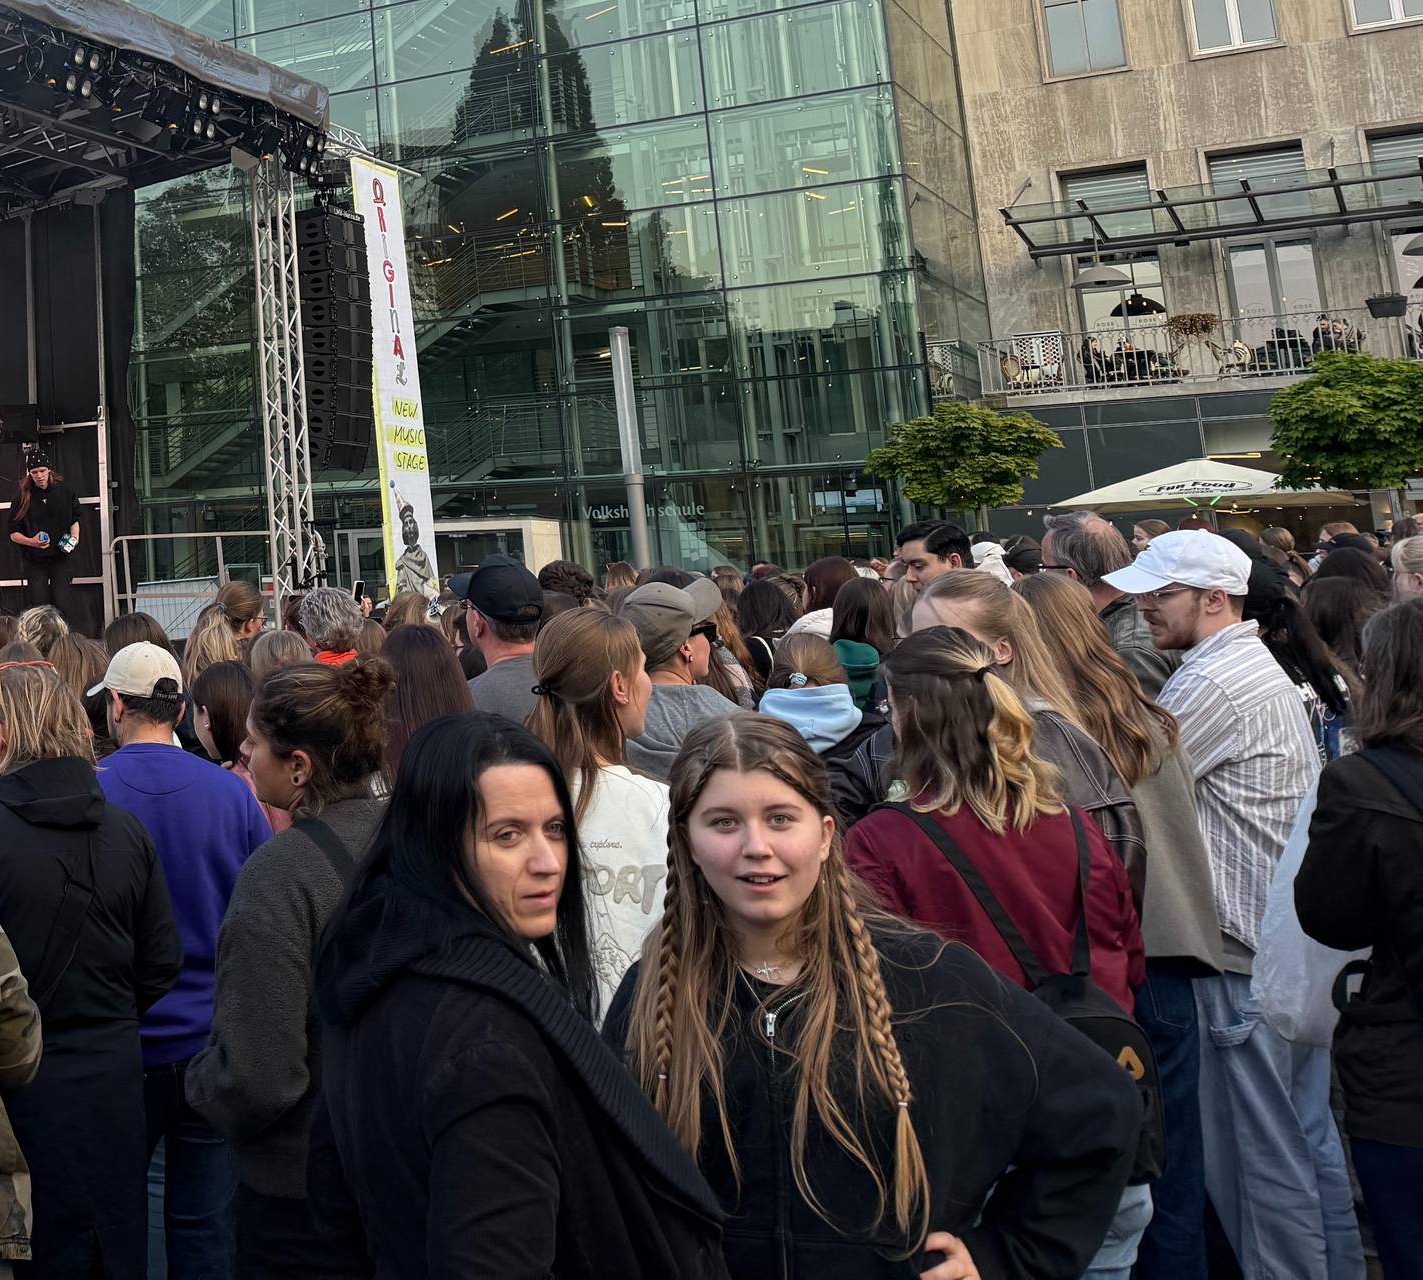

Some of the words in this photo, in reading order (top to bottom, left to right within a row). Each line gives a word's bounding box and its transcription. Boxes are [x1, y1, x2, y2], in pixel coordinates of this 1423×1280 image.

[394, 400, 418, 418] NEW
[394, 425, 424, 445] MUSIC
[397, 452, 424, 471] STAGE
[582, 501, 705, 520] Volkshhschule
